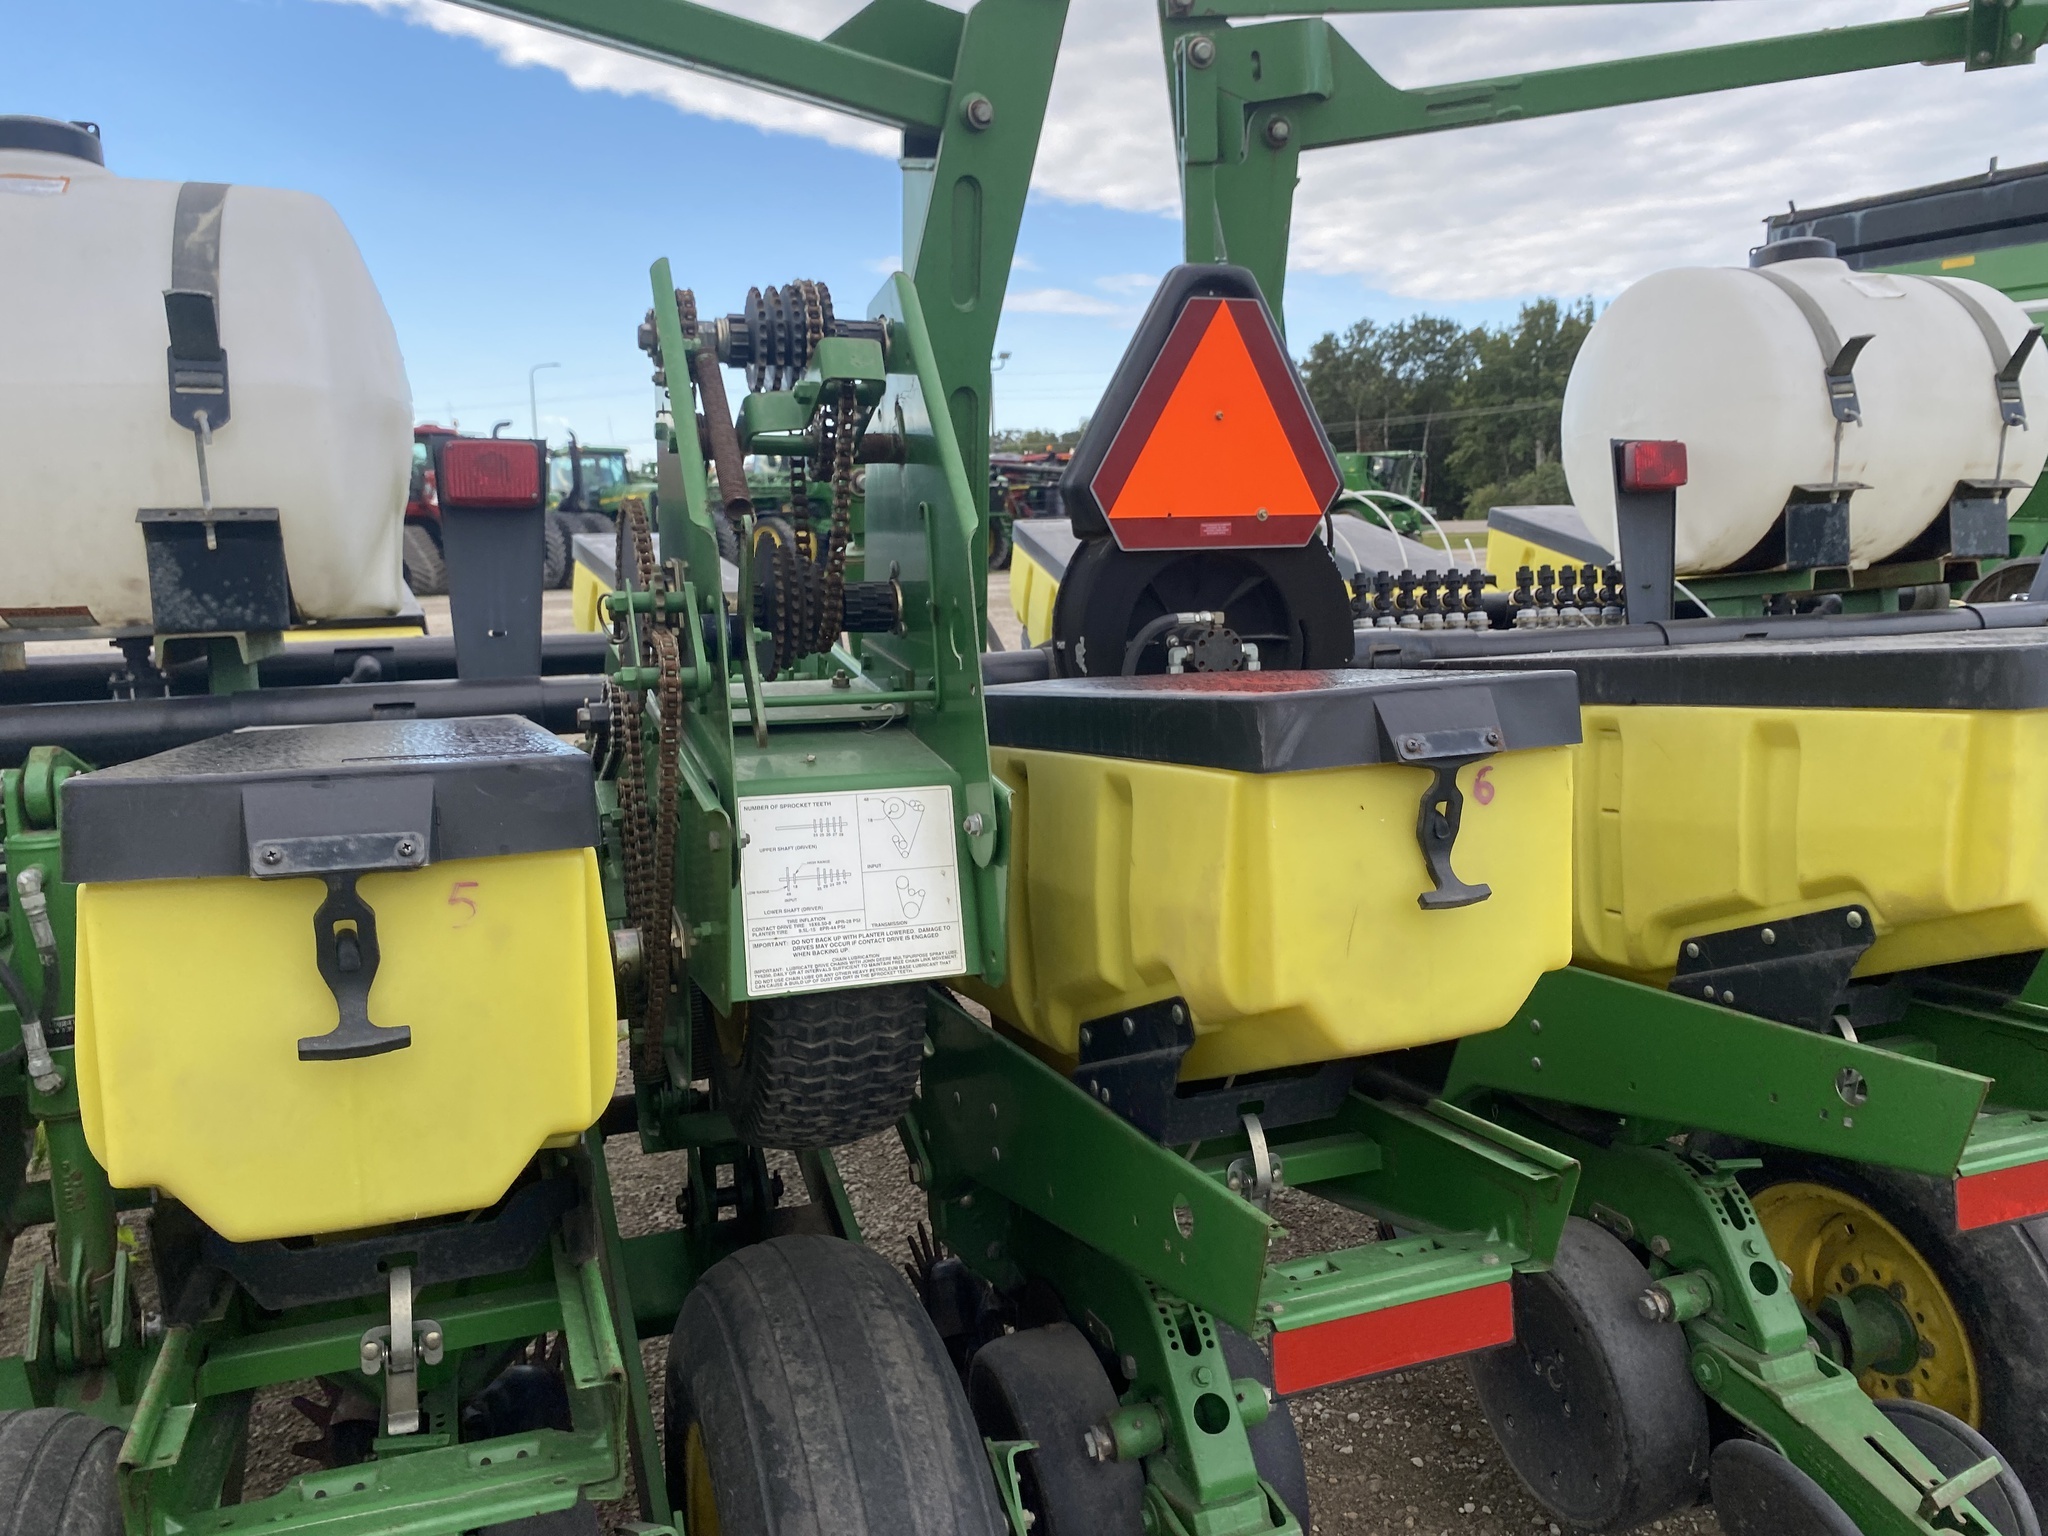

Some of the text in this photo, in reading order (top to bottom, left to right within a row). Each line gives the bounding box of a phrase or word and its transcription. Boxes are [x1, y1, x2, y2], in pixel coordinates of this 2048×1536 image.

[1473, 765, 1495, 805] 6
[448, 881, 478, 928] 5
[793, 944, 814, 952] DRIVES
[858, 937, 885, 945] CONTACT
[911, 932, 939, 940] ENGAGED
[858, 931, 885, 939] PLANTER
[812, 948, 838, 956] BACKING
[848, 953, 880, 961] LUBRICATION
